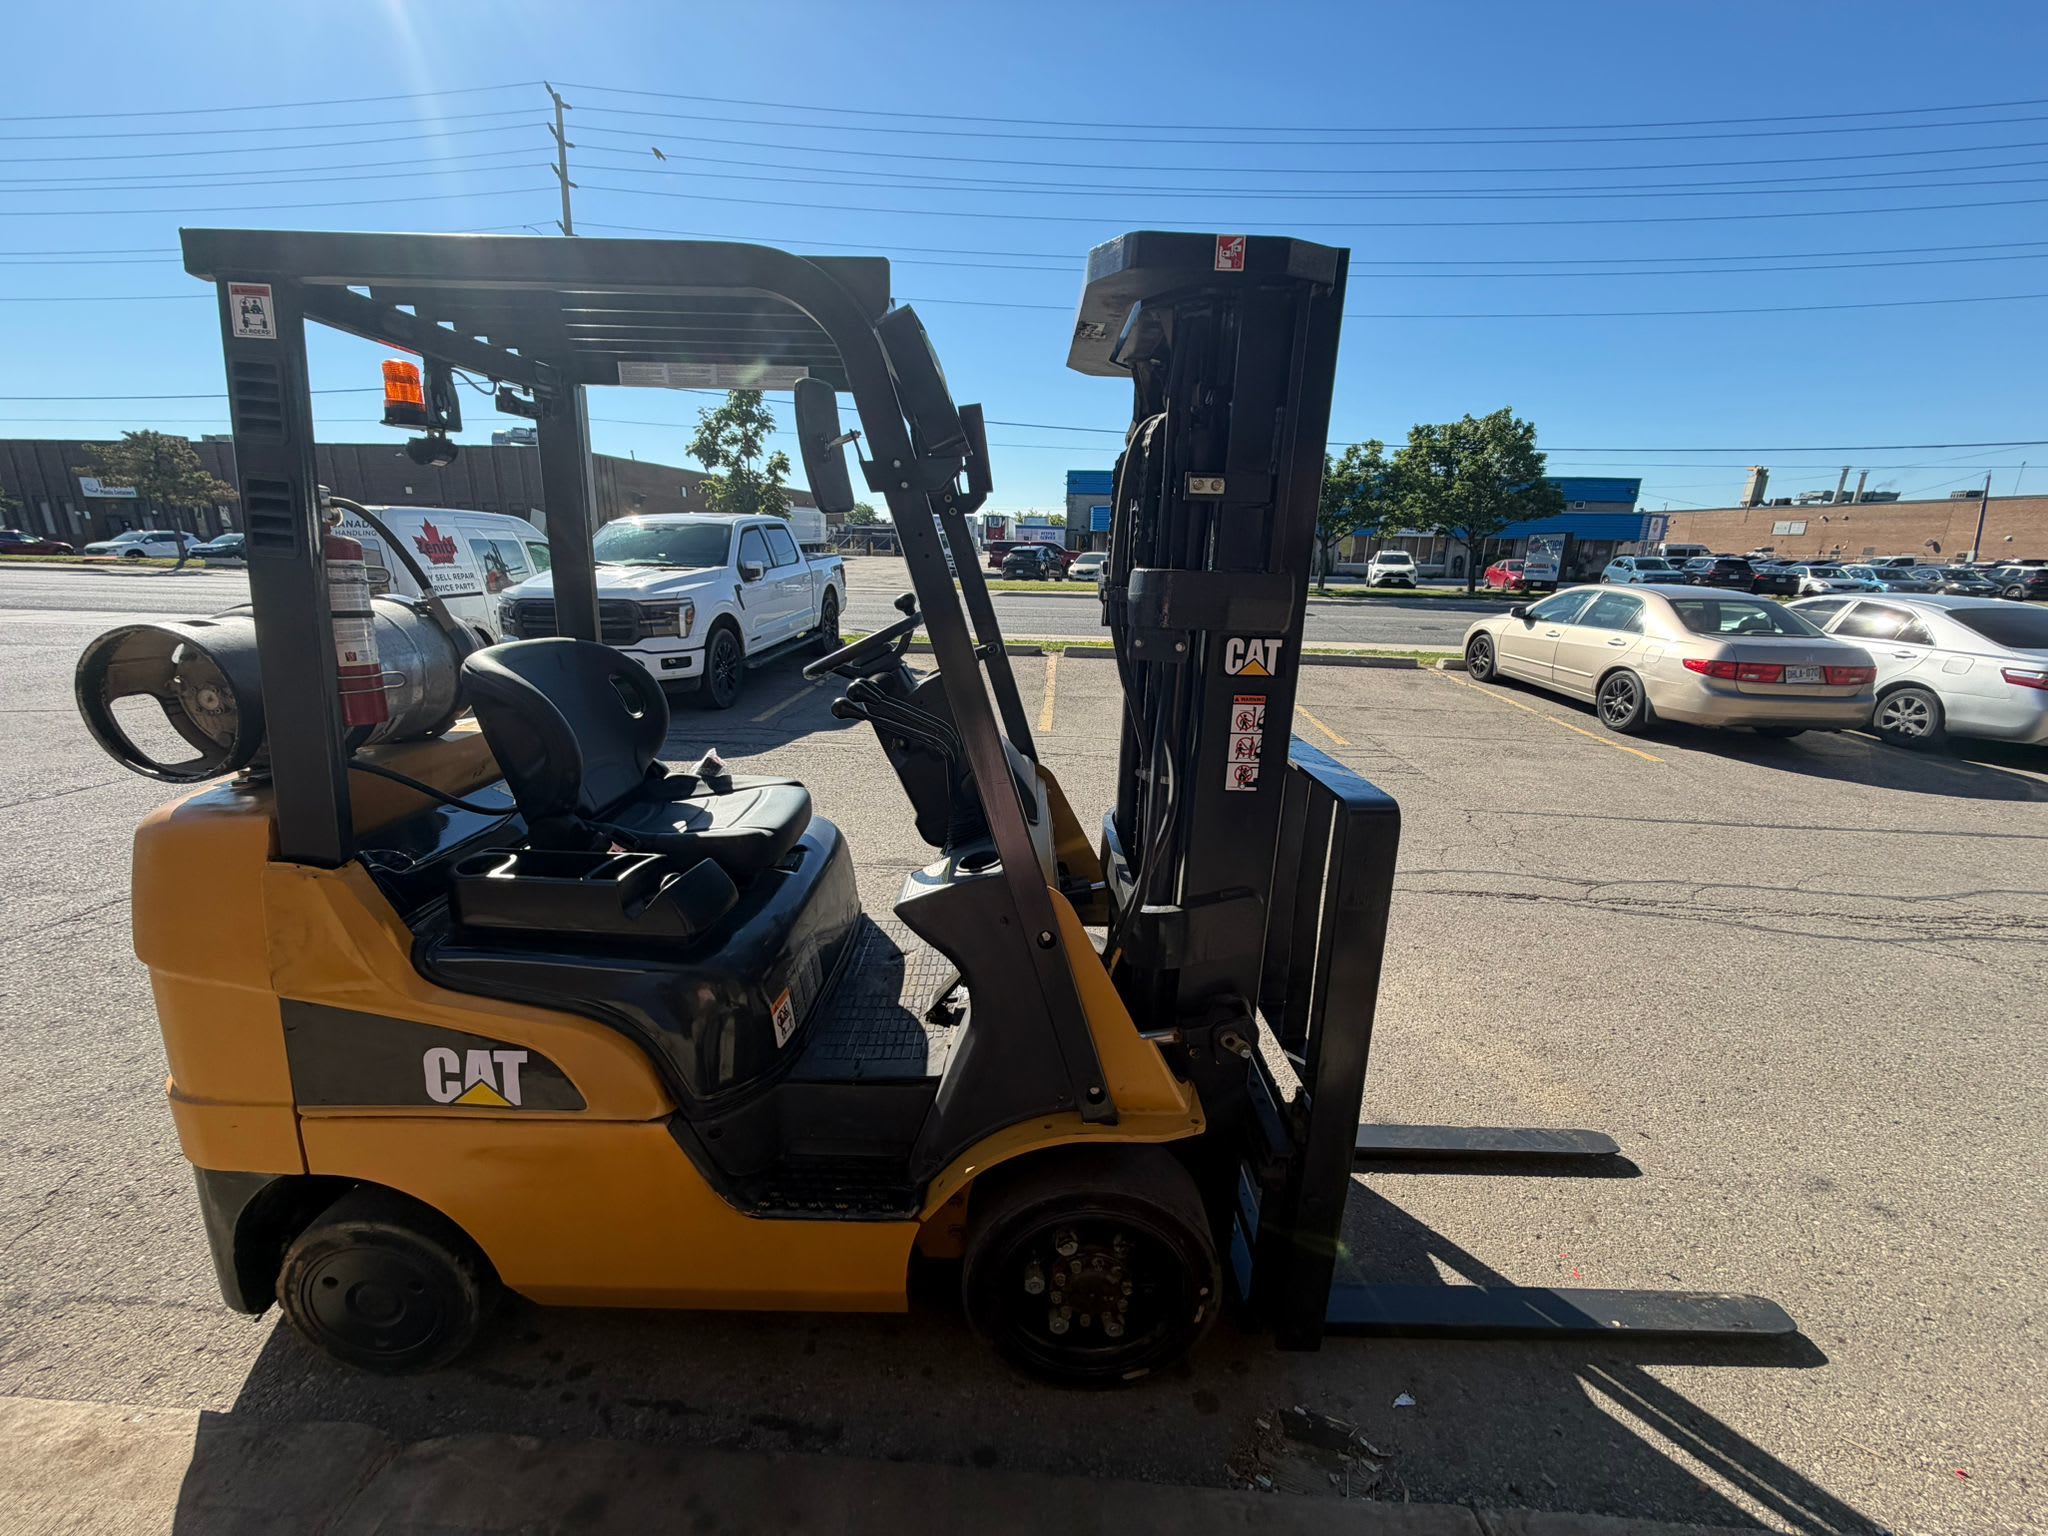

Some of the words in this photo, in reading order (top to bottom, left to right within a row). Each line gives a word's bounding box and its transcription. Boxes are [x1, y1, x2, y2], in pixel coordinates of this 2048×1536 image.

[433, 584, 454, 592] RVICE
[455, 582, 476, 591] PARTS
[435, 573, 452, 581] SELL
[453, 572, 475, 580] REPAIR
[1224, 637, 1283, 676] CAT
[423, 1047, 528, 1106] CAT
